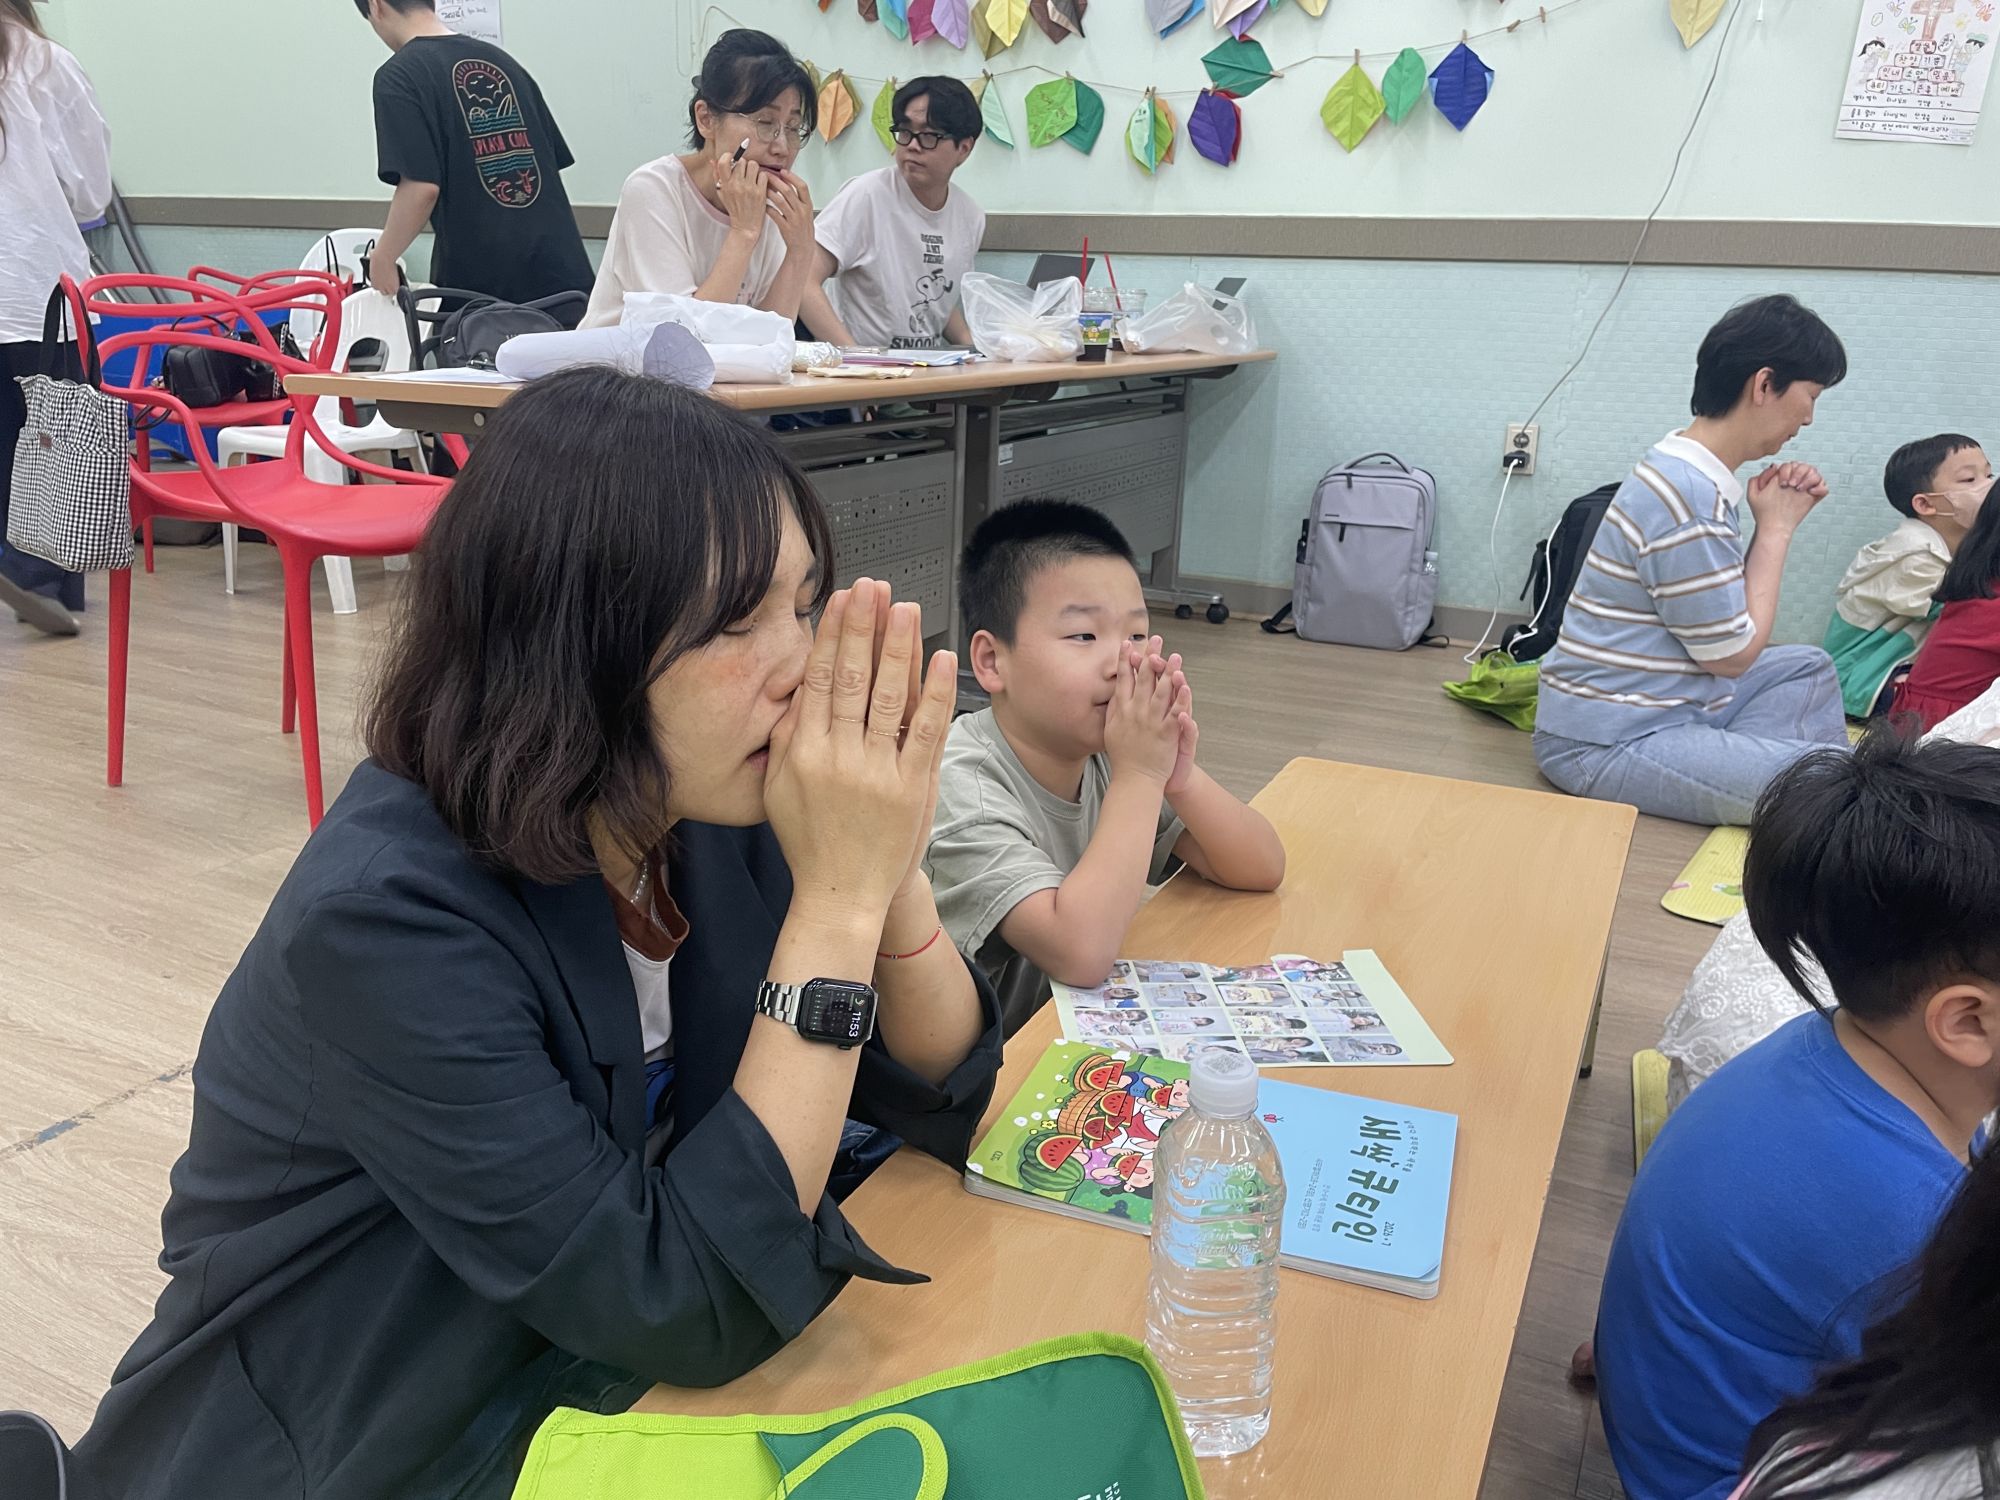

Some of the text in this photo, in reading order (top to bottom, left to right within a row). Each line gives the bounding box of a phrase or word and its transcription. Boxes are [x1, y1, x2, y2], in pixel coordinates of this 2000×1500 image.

[1899, 55, 1940, 66] 찬양 기쁨
[1883, 68, 1950, 80] 인내 소망 믿음
[1940, 85, 1960, 94] 예배
[849, 1011, 862, 1038] 11:53
